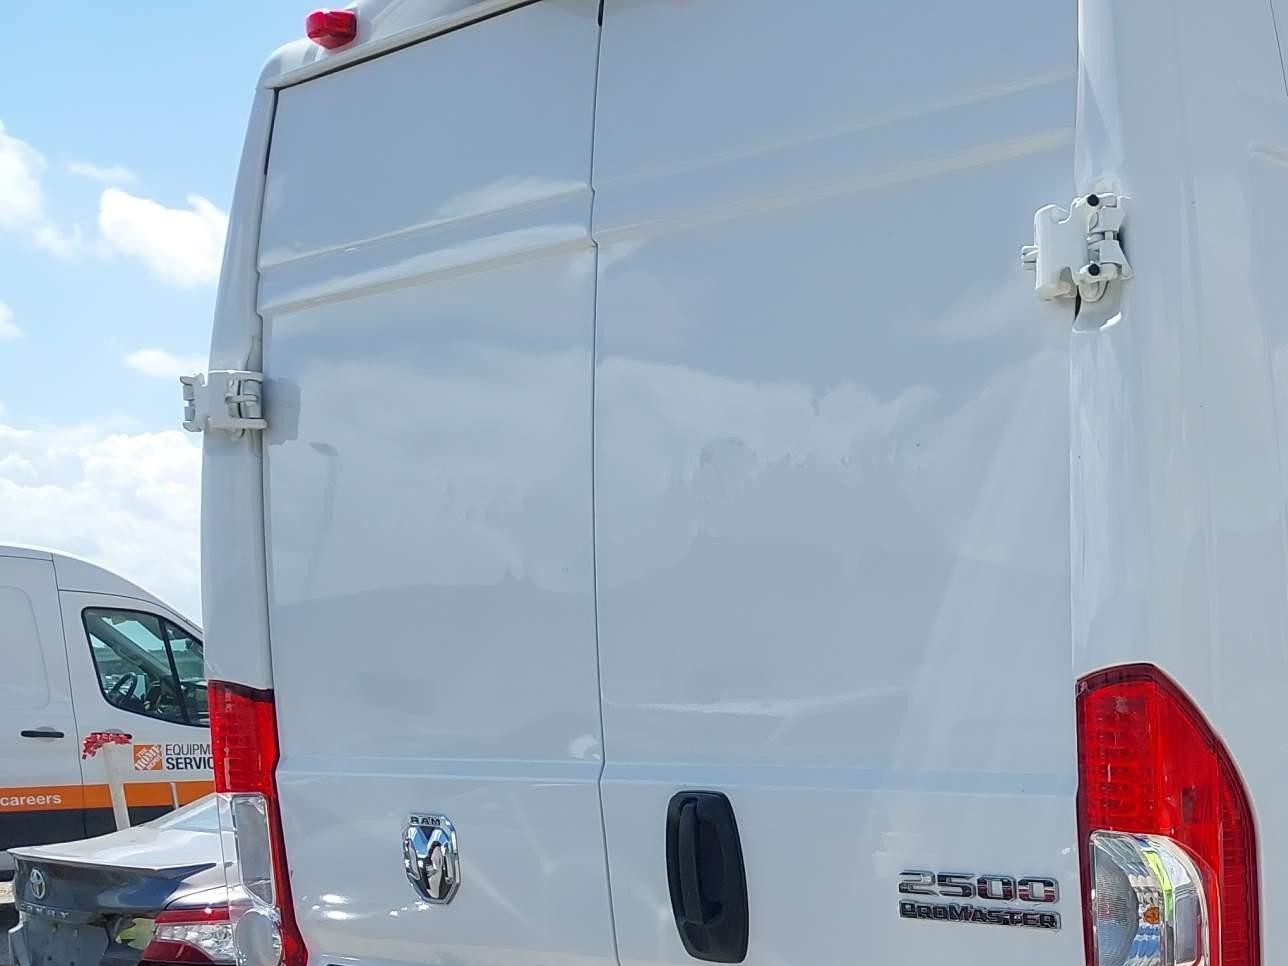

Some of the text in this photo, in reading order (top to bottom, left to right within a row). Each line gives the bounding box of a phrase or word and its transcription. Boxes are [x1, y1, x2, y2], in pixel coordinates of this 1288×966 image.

[165, 744, 211, 756] EQUIPM
[135, 744, 162, 771] HOME
[0, 794, 62, 806] careers
[410, 816, 441, 826] RAM
[898, 869, 1060, 904] 2500
